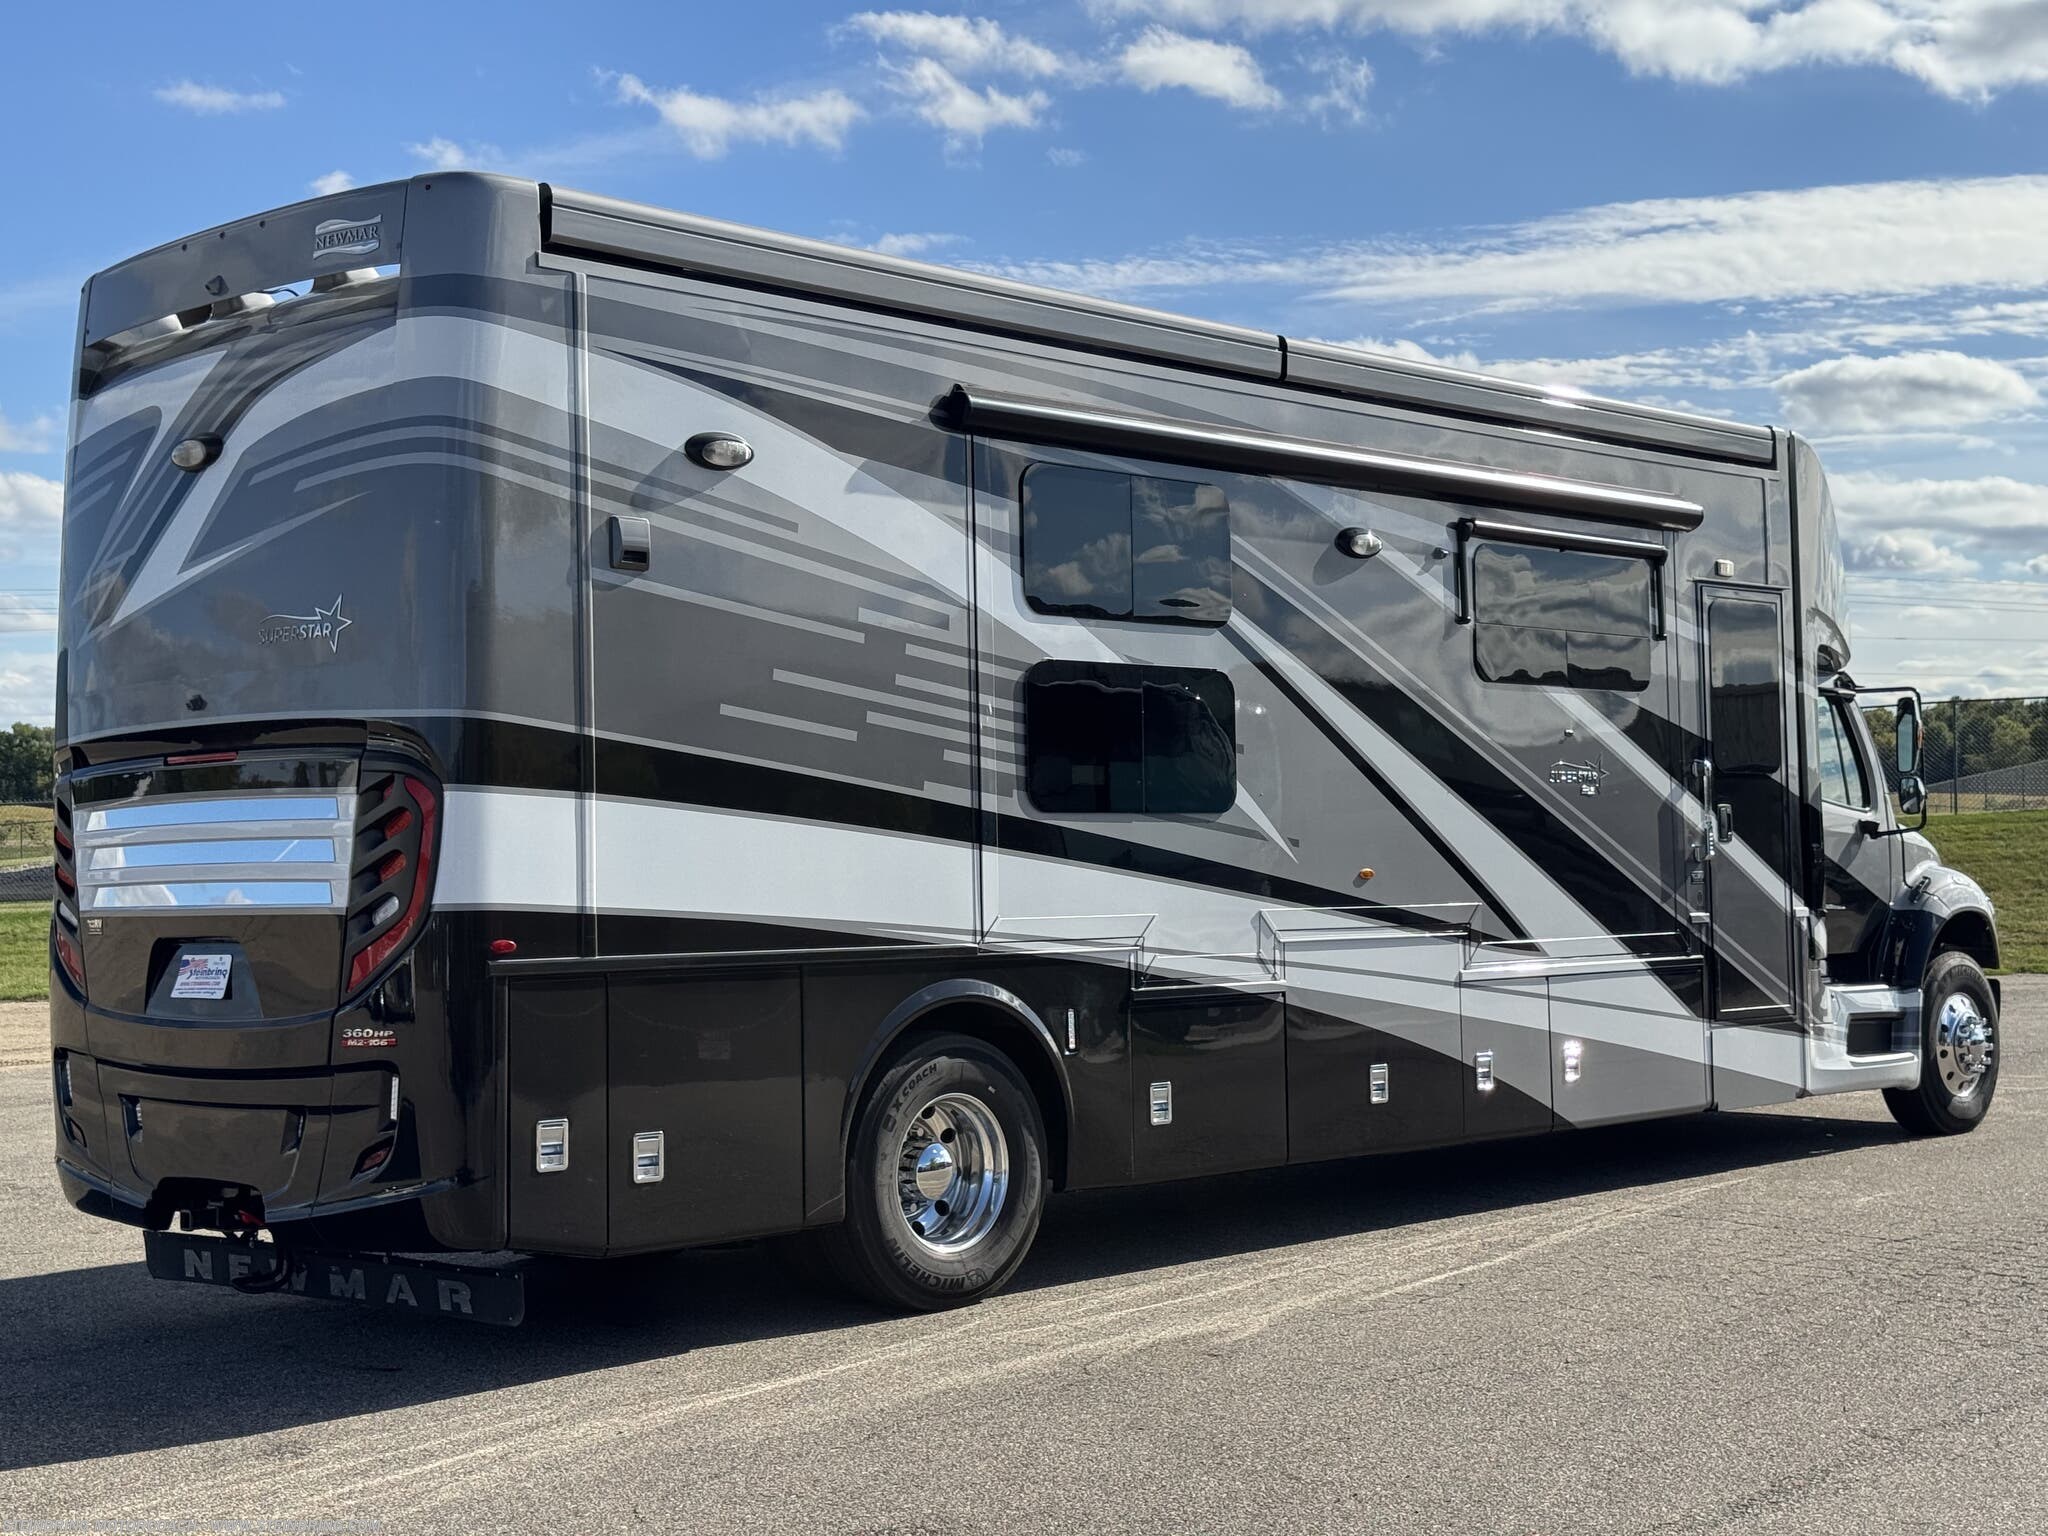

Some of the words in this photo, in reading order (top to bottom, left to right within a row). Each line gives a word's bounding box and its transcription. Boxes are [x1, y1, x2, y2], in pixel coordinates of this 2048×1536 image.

[315, 225, 379, 249] NEWMAR
[258, 622, 332, 645] SUPERSTAR
[902, 1062, 938, 1098] COACH
[888, 1237, 966, 1290] MICHELIN
